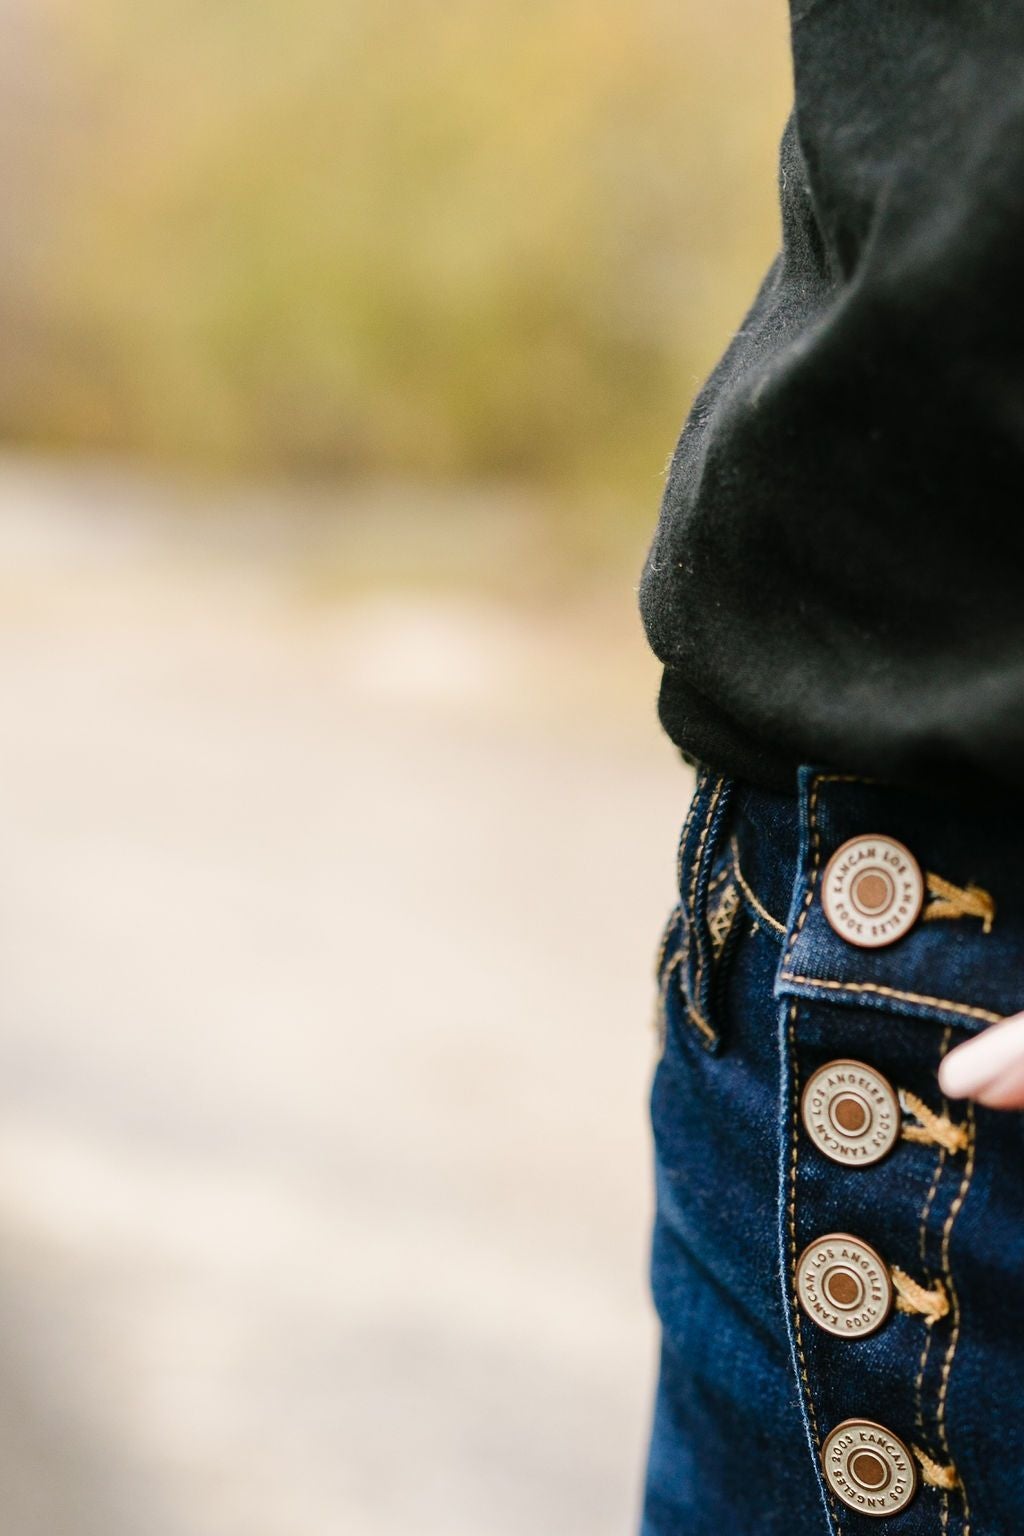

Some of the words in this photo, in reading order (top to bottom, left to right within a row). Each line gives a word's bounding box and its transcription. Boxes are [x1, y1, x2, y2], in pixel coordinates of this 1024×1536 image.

[834, 848, 876, 893] KANCAN
[883, 851, 907, 875] LOS
[872, 882, 911, 936] ANGELES
[812, 1089, 826, 1115] LOS
[827, 1074, 884, 1104] ANGELES
[816, 1124, 868, 1156] KANCAN
[811, 1249, 834, 1268] LOS
[841, 1249, 881, 1301] ANGELES
[805, 1272, 838, 1325] KANCAN
[845, 1308, 877, 1328] 2003
[831, 1435, 853, 1463] 2003
[859, 1432, 906, 1471] KANCAN
[833, 1469, 885, 1507] ANGELES
[889, 1478, 907, 1501] LOS
